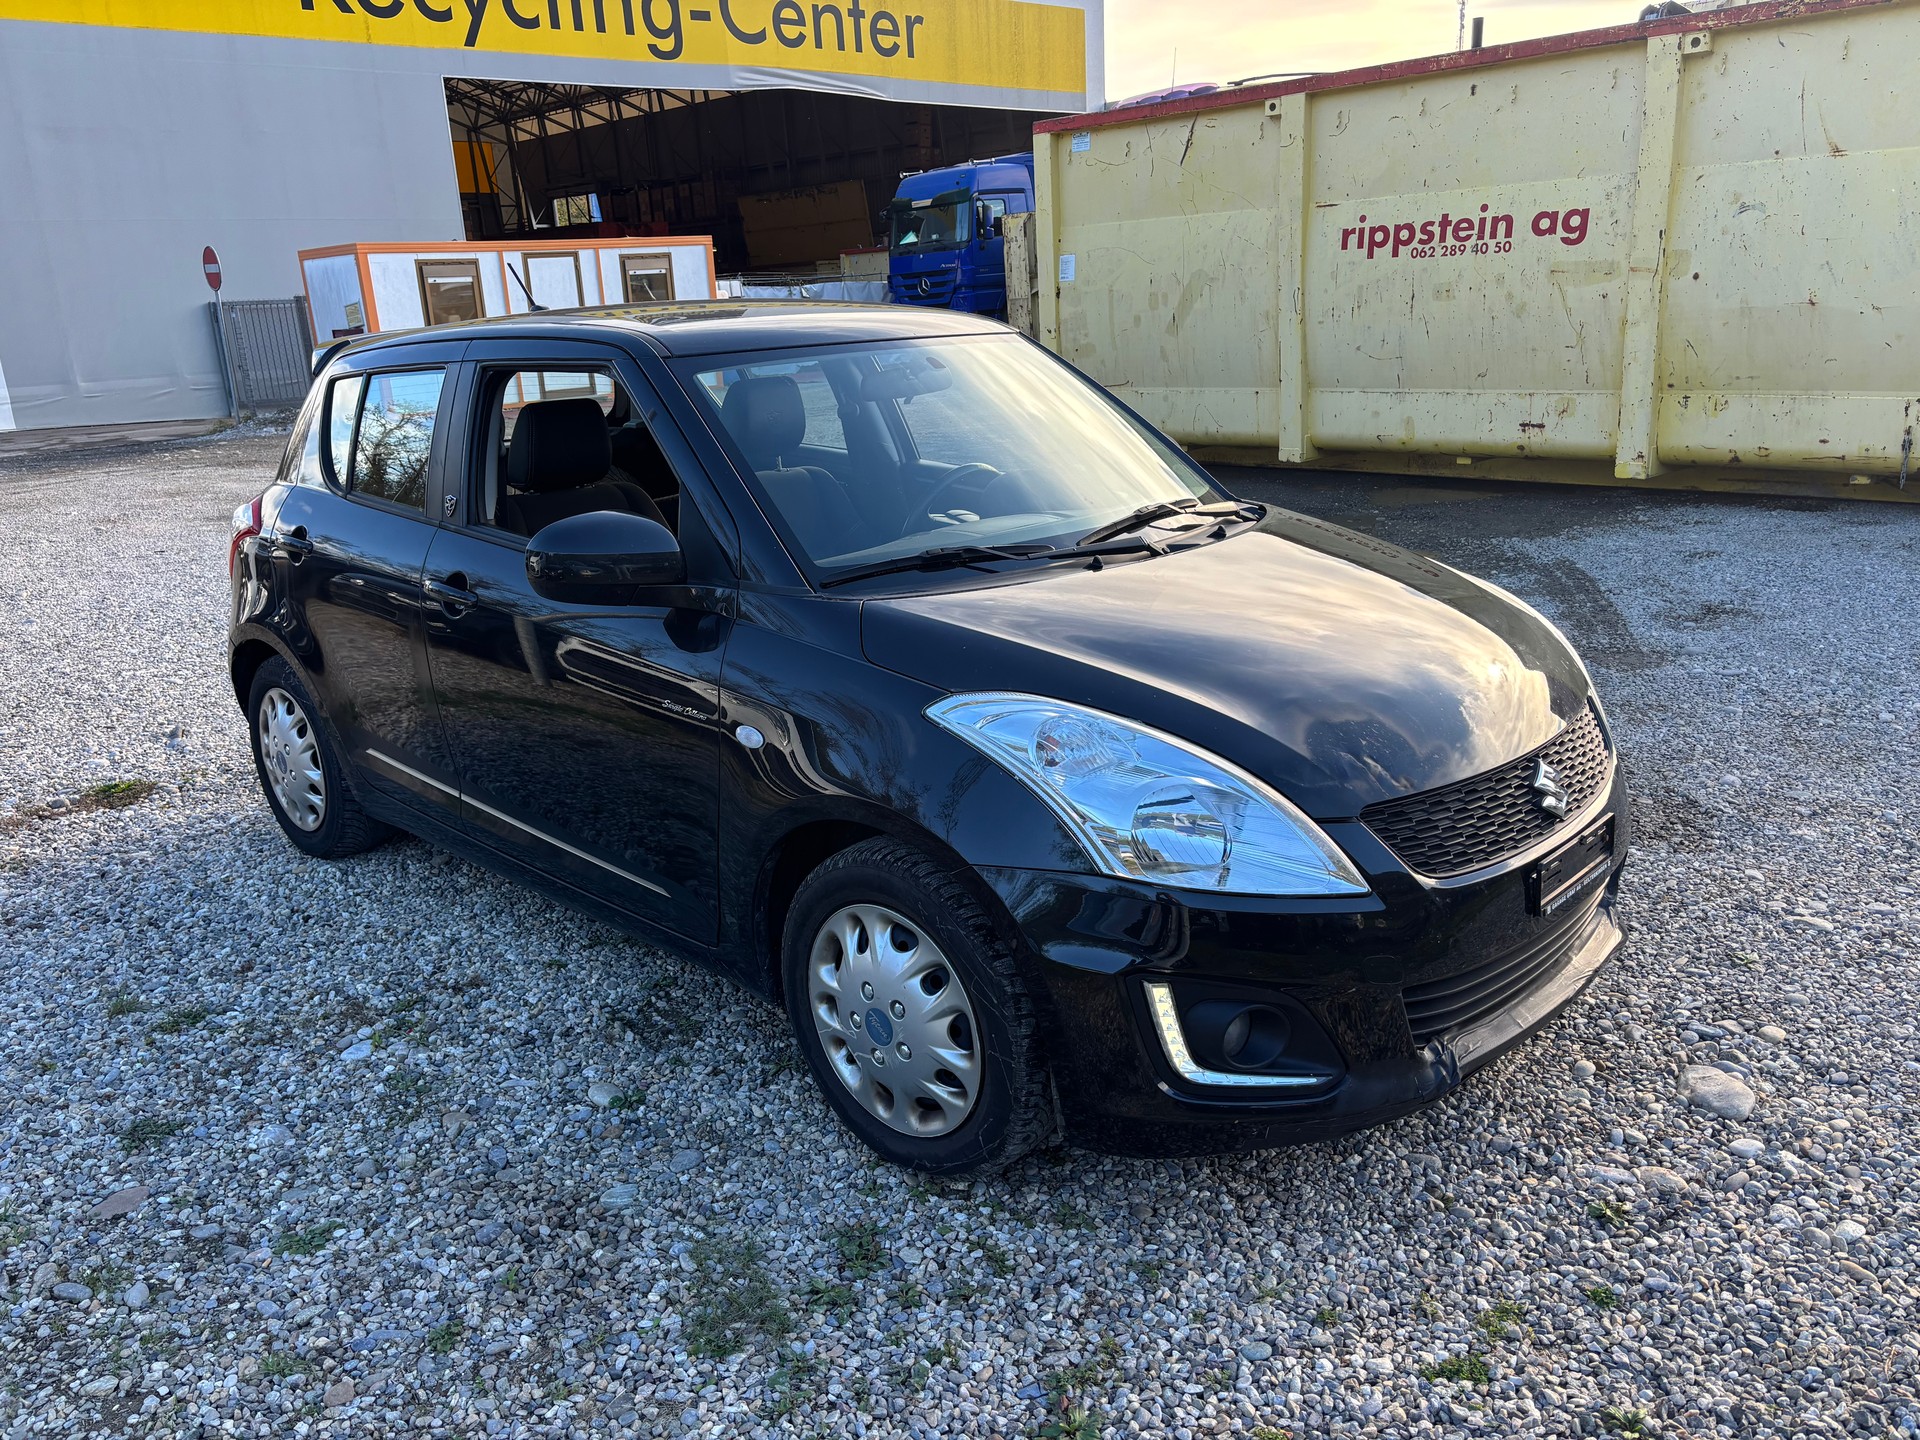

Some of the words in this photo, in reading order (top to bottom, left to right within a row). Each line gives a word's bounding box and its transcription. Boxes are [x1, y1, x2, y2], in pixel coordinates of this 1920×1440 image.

[301, 0, 924, 60] ycng-Center
[1341, 203, 1514, 259] rippstein
[1531, 208, 1590, 246] ag
[1410, 247, 1436, 259] 062
[1441, 244, 1467, 257] 289
[1470, 243, 1489, 255] 40
[1493, 241, 1512, 254] 50
